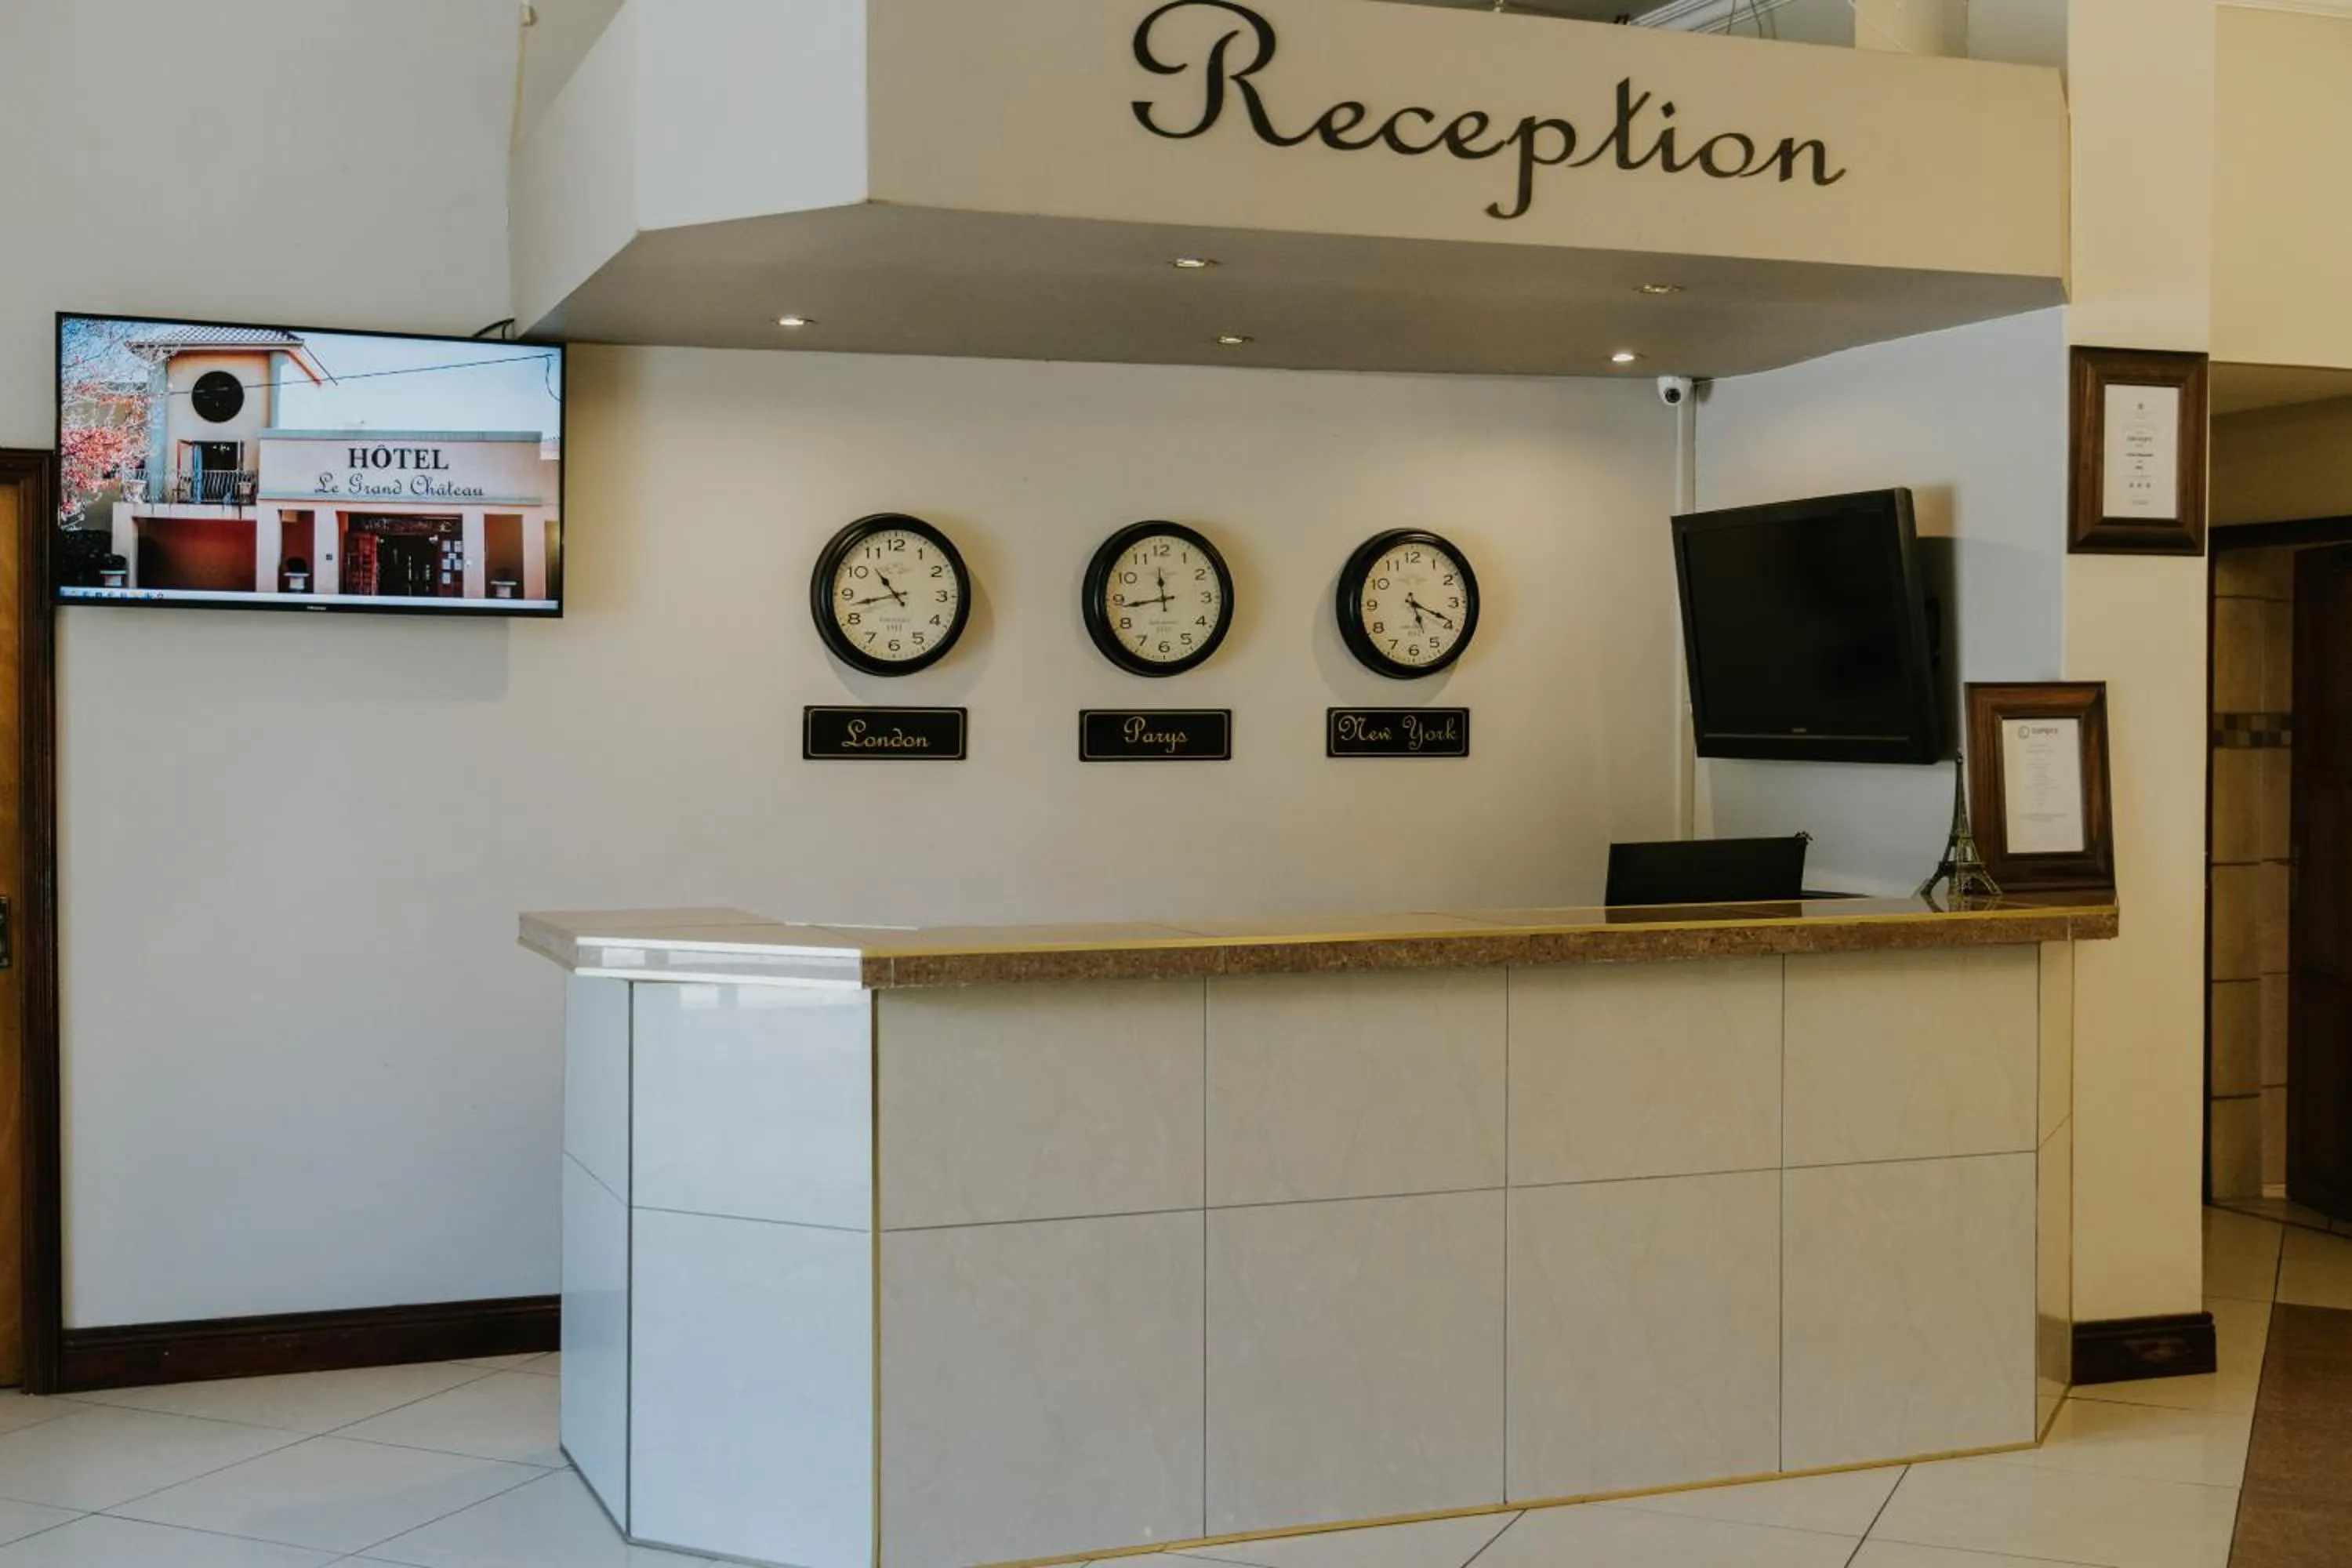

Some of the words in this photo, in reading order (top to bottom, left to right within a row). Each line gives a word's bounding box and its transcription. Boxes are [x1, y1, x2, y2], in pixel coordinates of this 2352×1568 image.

[1130, 0, 1846, 220] Reception
[348, 444, 449, 470] HÔTEL
[314, 472, 339, 494] Le
[348, 472, 403, 495] Grand
[410, 474, 485, 496] Château
[887, 539, 906, 552] 12
[1152, 544, 1171, 557] 12
[866, 547, 881, 559] 11
[917, 547, 923, 560] 1
[1134, 553, 1148, 565] 11
[1181, 551, 1187, 564] 1
[1404, 551, 1421, 563] 12
[1386, 560, 1399, 572] 11
[1432, 559, 1436, 570] 1
[848, 565, 869, 579] 10
[931, 565, 943, 578] 2
[1195, 568, 1206, 580] 2
[1119, 572, 1137, 584] 10
[1372, 578, 1390, 590] 10
[1443, 574, 1454, 586] 2
[841, 588, 854, 601] 9
[935, 590, 948, 603] 3
[1112, 593, 1125, 606] 9
[1200, 591, 1212, 604] 3
[1367, 600, 1378, 612] 9
[1448, 597, 1459, 608] 3
[848, 612, 861, 625] 8
[929, 614, 942, 626] 4
[1120, 617, 1132, 629] 8
[1195, 615, 1207, 626] 4
[1443, 619, 1454, 630] 4
[1373, 622, 1385, 633] 8
[865, 631, 877, 644] 7
[912, 631, 924, 644] 5
[1137, 634, 1148, 647] 7
[1181, 633, 1192, 645] 5
[1429, 637, 1440, 648] 5
[888, 639, 901, 652] 6
[1158, 641, 1171, 653] 6
[1388, 639, 1399, 650] 7
[1409, 644, 1420, 656] 6
[841, 719, 931, 747] London
[1123, 716, 1189, 753] Parys
[1338, 715, 1392, 741] New
[1402, 715, 1457, 750] York
